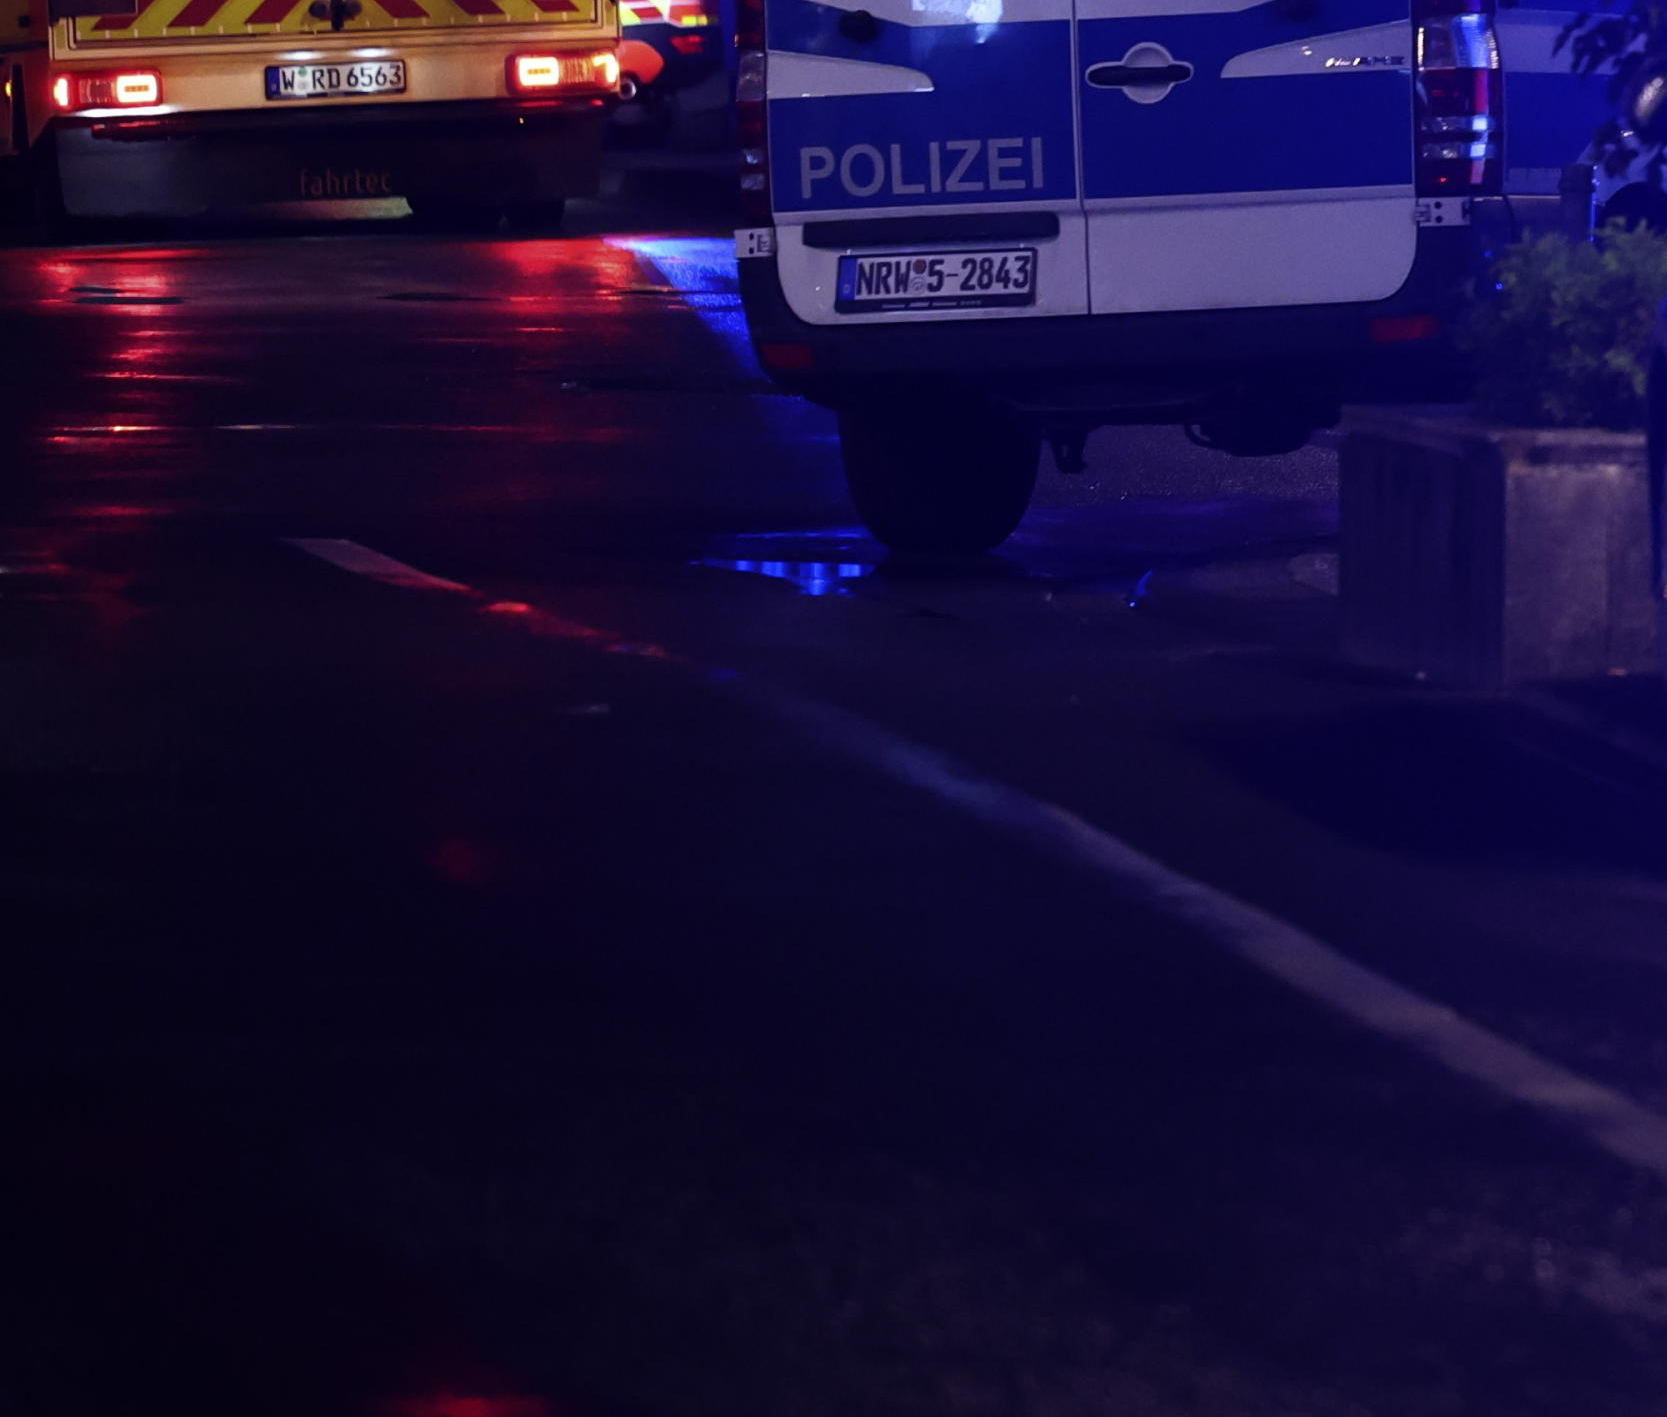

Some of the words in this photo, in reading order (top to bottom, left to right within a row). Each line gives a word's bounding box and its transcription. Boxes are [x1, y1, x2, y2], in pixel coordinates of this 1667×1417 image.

[281, 69, 295, 91] W
[312, 67, 341, 90] RD
[346, 63, 402, 88] 6563
[299, 165, 394, 197] fahrtec
[800, 135, 1046, 200] POLIZEI
[857, 260, 911, 296] NRW
[926, 254, 1031, 294] 5-2843
